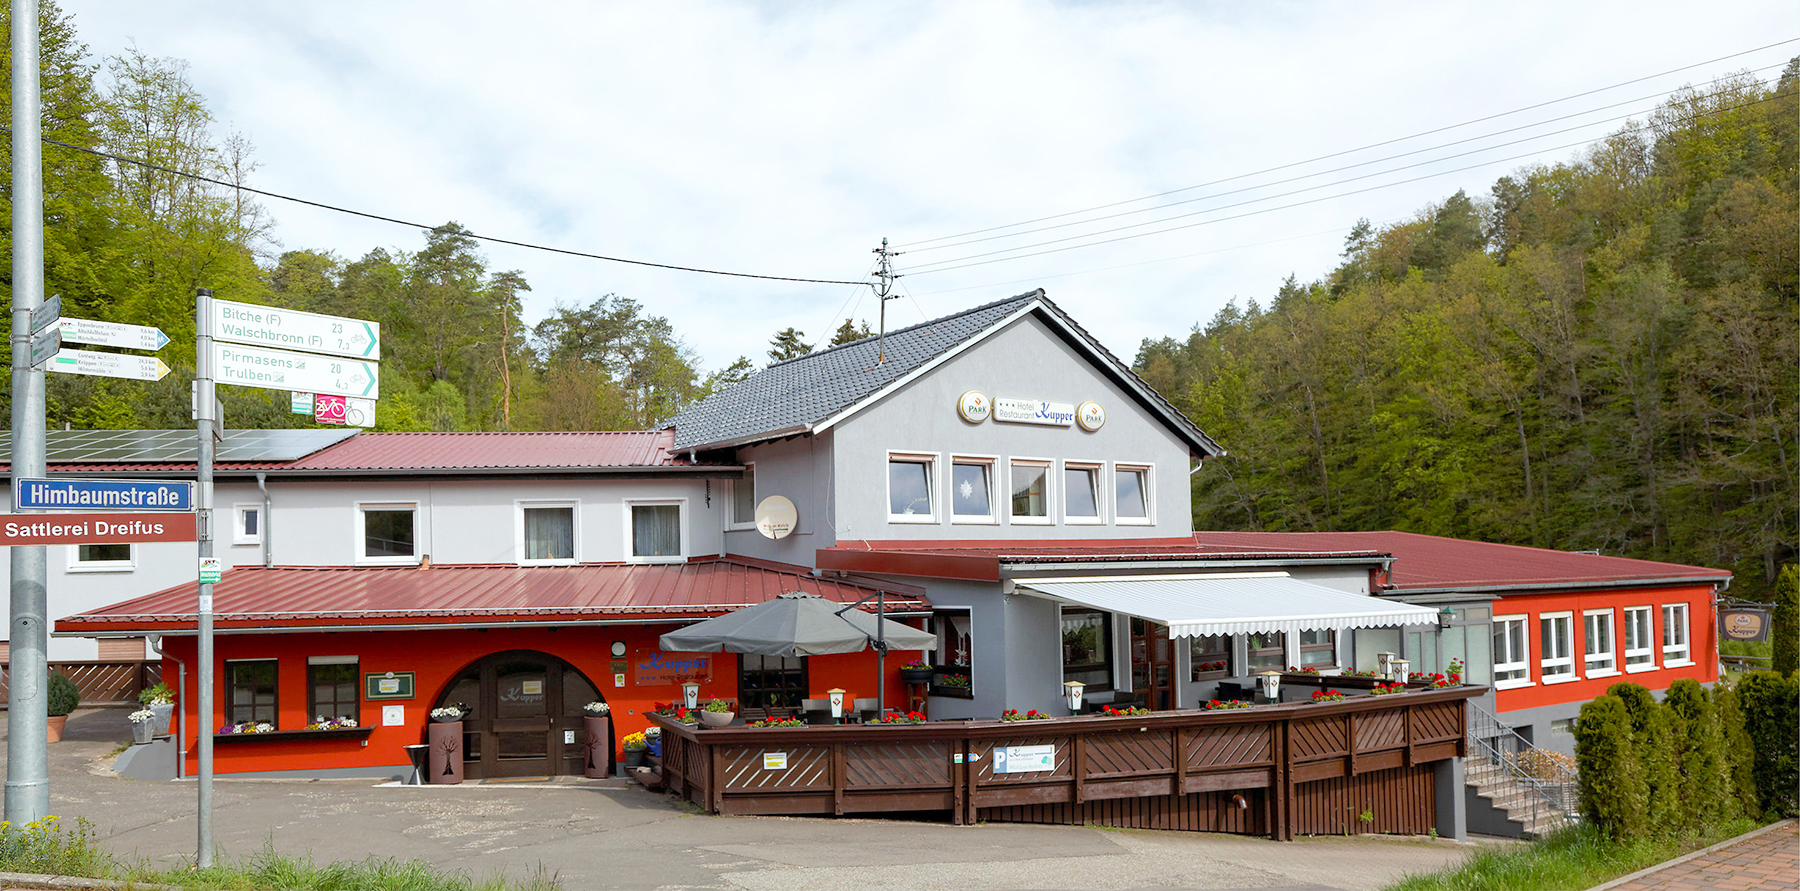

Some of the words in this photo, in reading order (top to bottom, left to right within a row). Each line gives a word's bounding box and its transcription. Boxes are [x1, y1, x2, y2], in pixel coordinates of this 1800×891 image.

[223, 307, 262, 323] Bitche
[266, 314, 281, 326] (F)
[332, 323, 343, 334] 23
[222, 323, 304, 344] Walschbronn
[308, 335, 323, 348] (F)
[222, 350, 293, 368] Pirmasens
[331, 363, 342, 374] 20
[223, 366, 272, 381] Trulben
[968, 405, 987, 413] PARK
[999, 409, 1035, 419] Restaurant
[1035, 402, 1073, 423] Kupper
[1017, 402, 1035, 410] Hotel
[1085, 414, 1102, 422] PARK
[31, 484, 179, 506] Himbaumstraße
[5, 522, 89, 537] Sattlerei
[95, 520, 164, 536] Dreifus
[640, 653, 707, 673] Kupper
[500, 687, 543, 703] Kupper
[994, 751, 1006, 770] P
